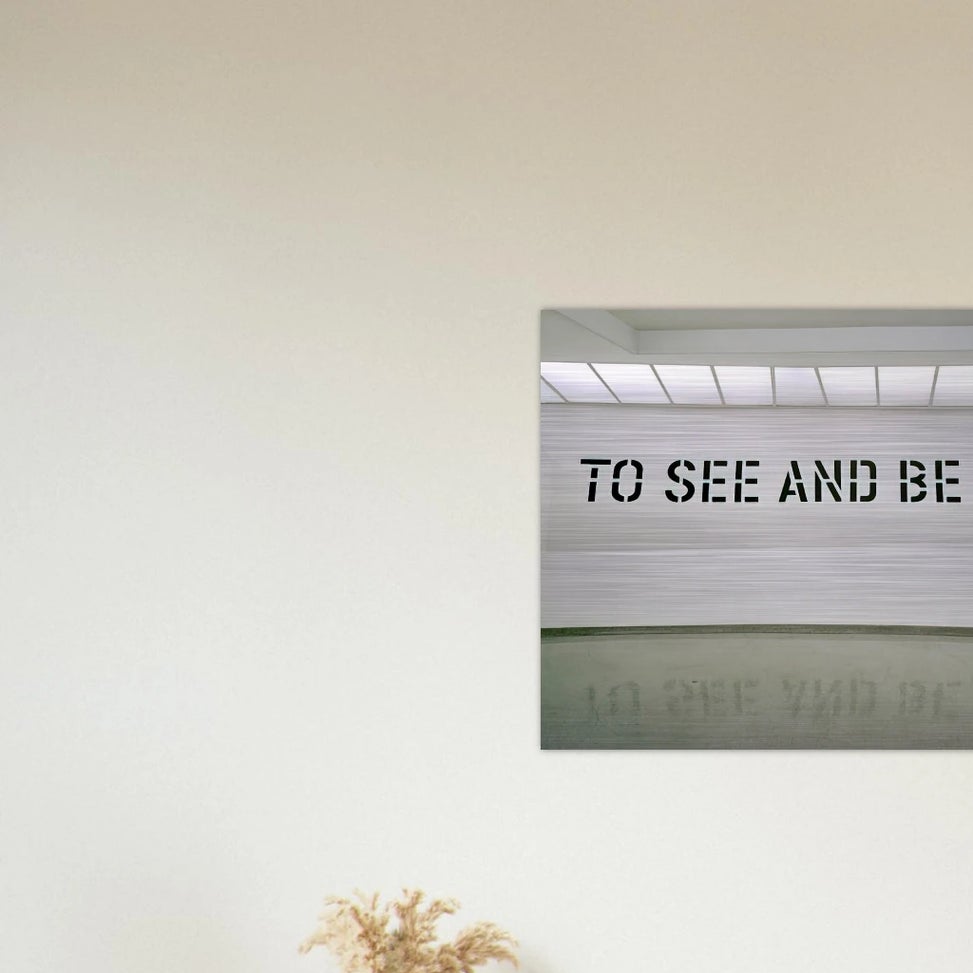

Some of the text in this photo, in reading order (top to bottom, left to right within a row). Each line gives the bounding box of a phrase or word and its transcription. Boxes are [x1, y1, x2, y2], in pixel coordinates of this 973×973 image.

[580, 458, 644, 503] TO
[664, 459, 760, 503] SEE
[778, 459, 877, 503] AND
[899, 460, 962, 503] BE
